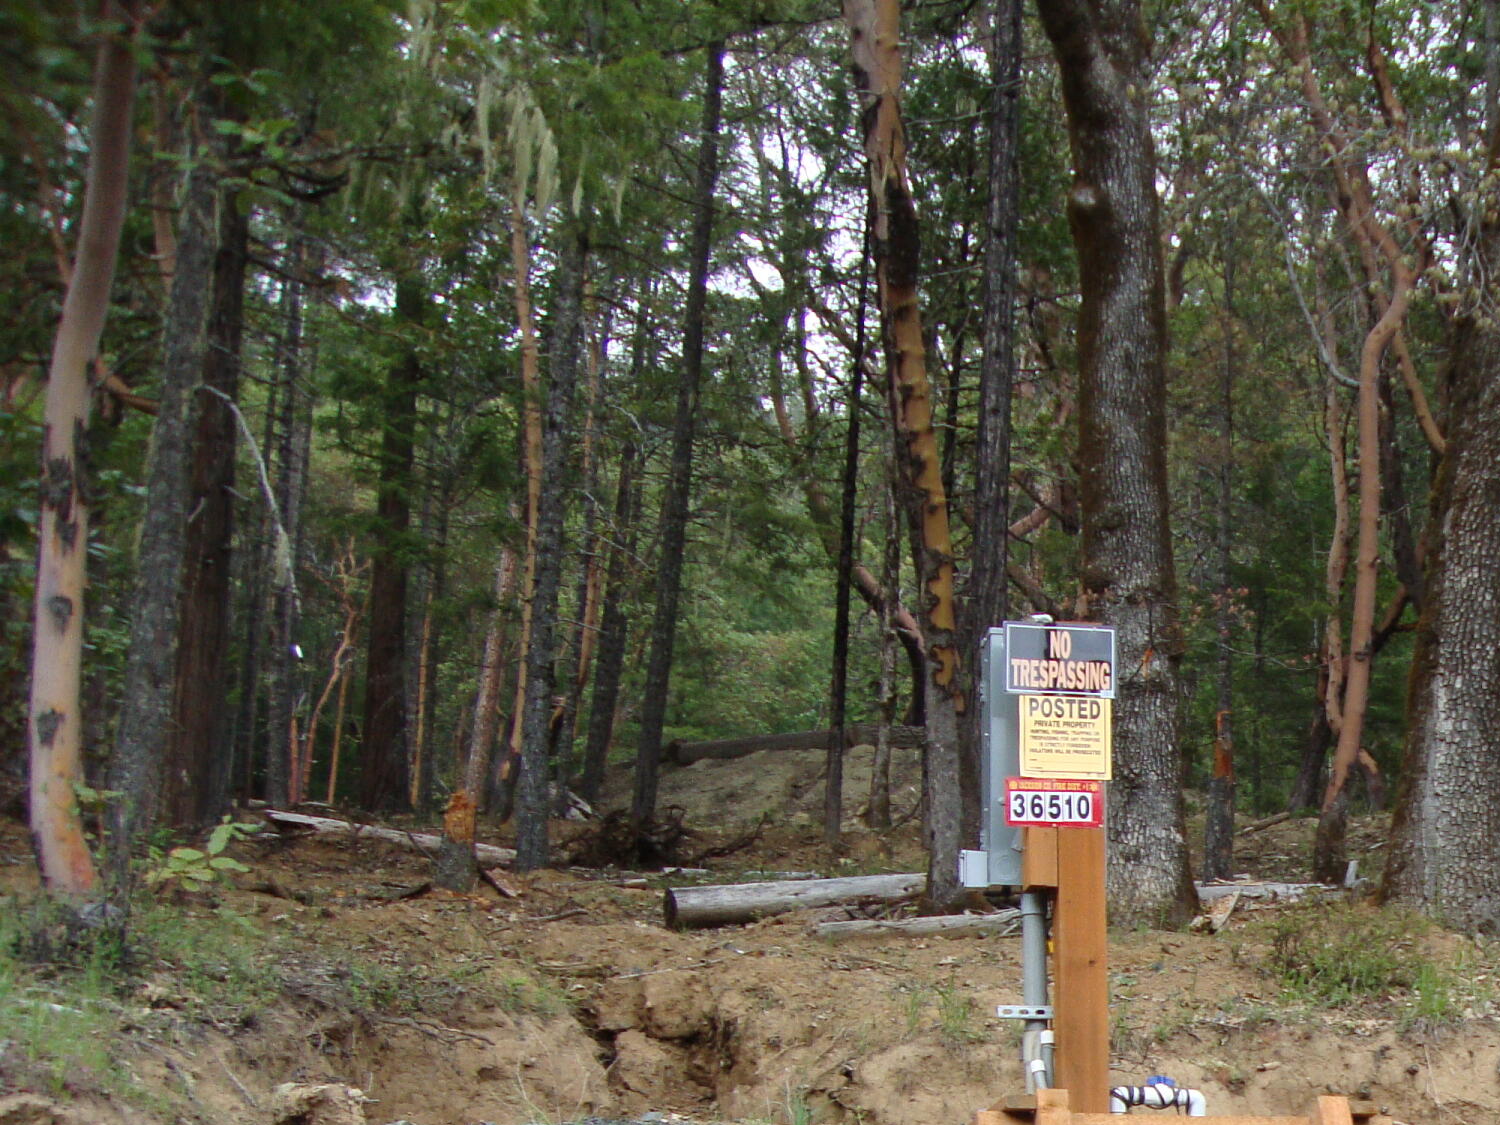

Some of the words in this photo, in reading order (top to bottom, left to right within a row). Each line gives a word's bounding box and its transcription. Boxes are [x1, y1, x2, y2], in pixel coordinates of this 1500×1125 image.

[1049, 630, 1072, 659] NO
[1011, 658, 1111, 690] TRESPASSING
[1029, 697, 1101, 719] POSTED
[1034, 720, 1061, 728] PRIVATE
[1062, 721, 1095, 729] PROPERTY
[1013, 794, 1090, 819] 36510
